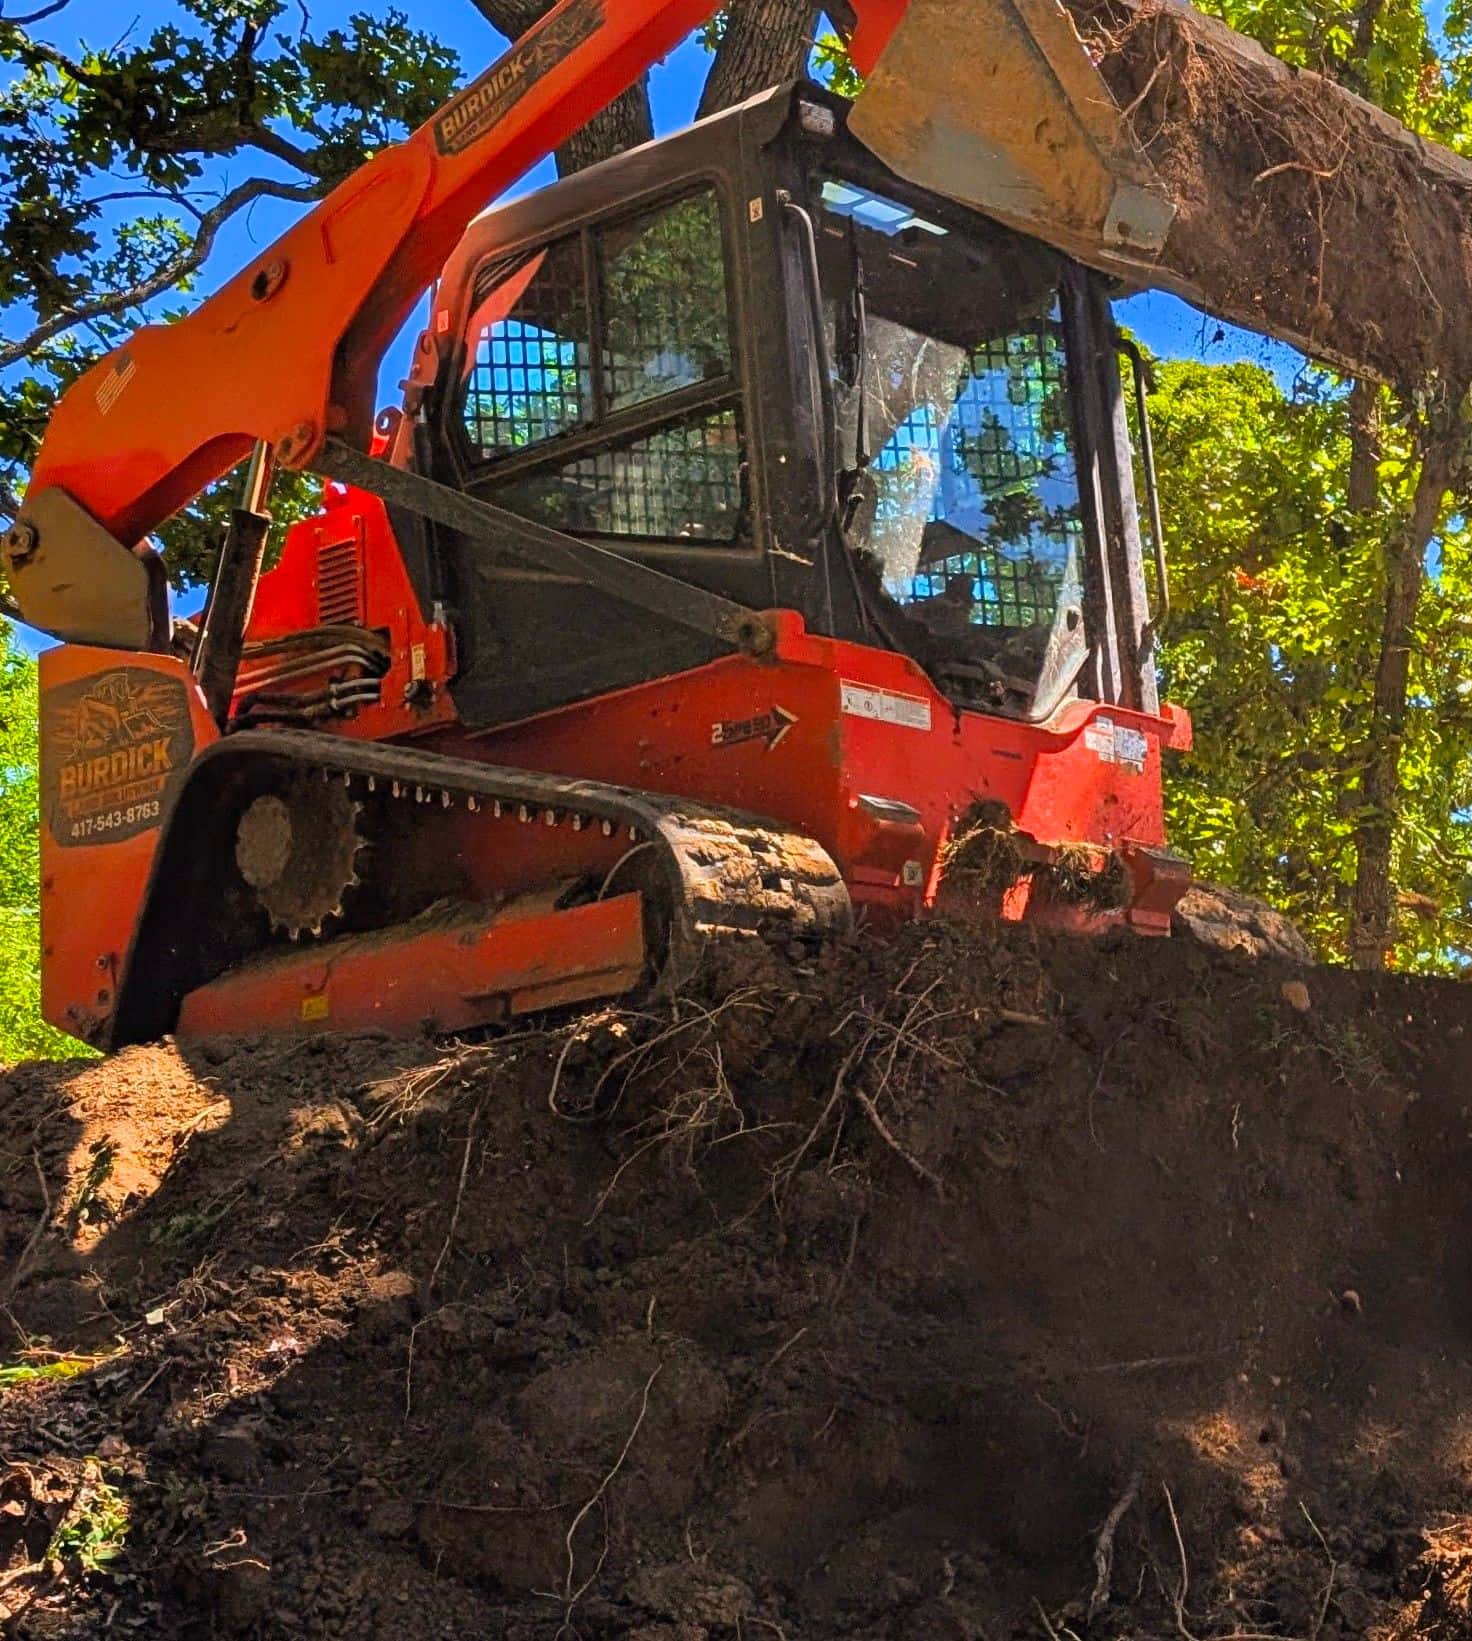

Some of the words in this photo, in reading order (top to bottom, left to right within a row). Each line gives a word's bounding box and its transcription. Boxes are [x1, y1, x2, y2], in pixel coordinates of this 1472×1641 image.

[441, 52, 526, 139] BURDICK
[711, 722, 723, 744] 2
[61, 736, 173, 796] BURDICK
[71, 800, 160, 837] 417-543-8763
